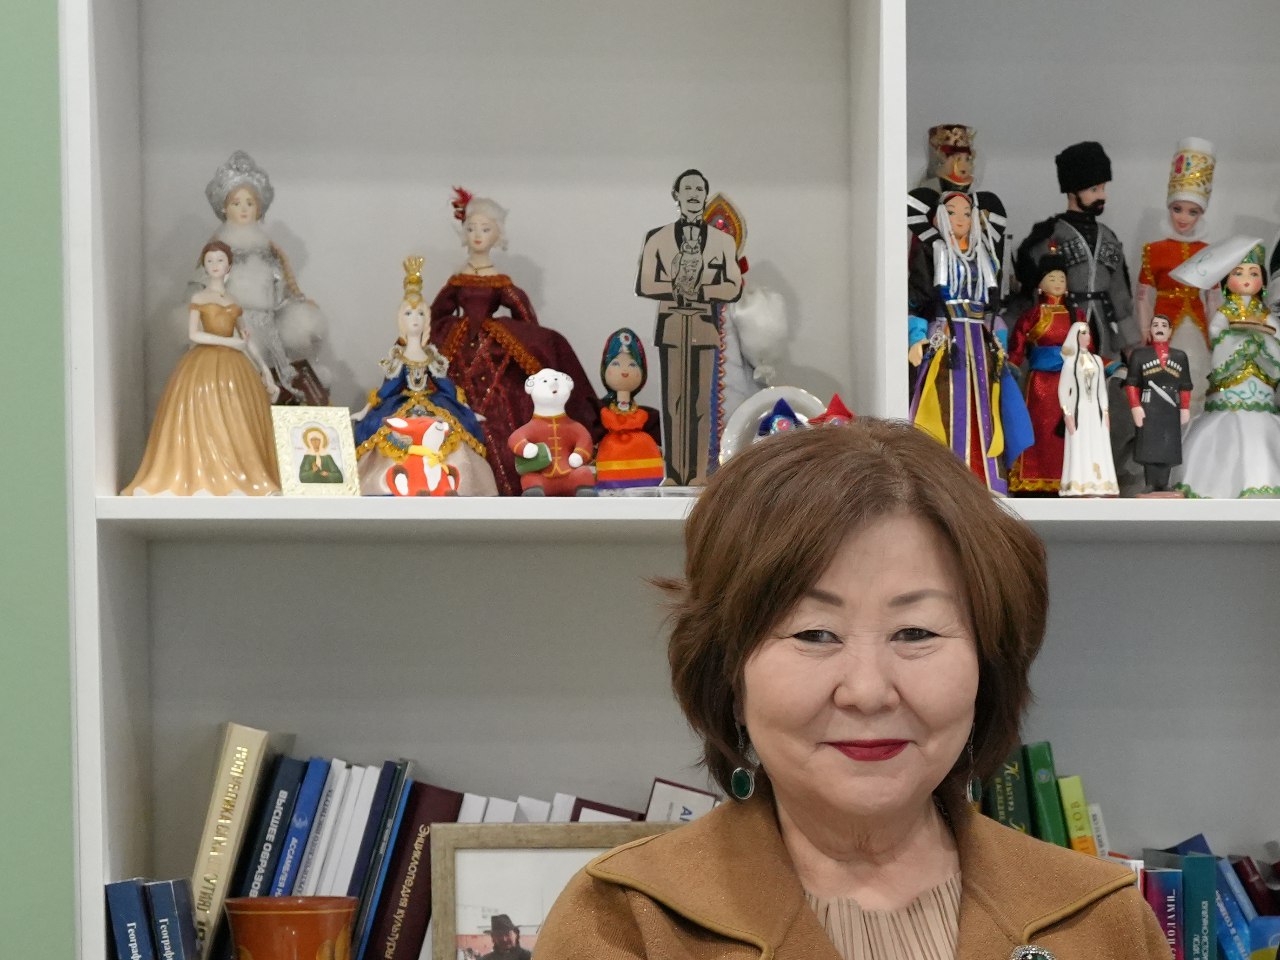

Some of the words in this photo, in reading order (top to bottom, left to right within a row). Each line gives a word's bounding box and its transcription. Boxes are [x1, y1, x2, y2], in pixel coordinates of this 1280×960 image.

[265, 788, 288, 842] ВЫСШЕЕ
[277, 836, 298, 887] АССАМБЛЕЯ
[398, 823, 430, 907] Энциклопедия
[382, 908, 405, 959] культуры
